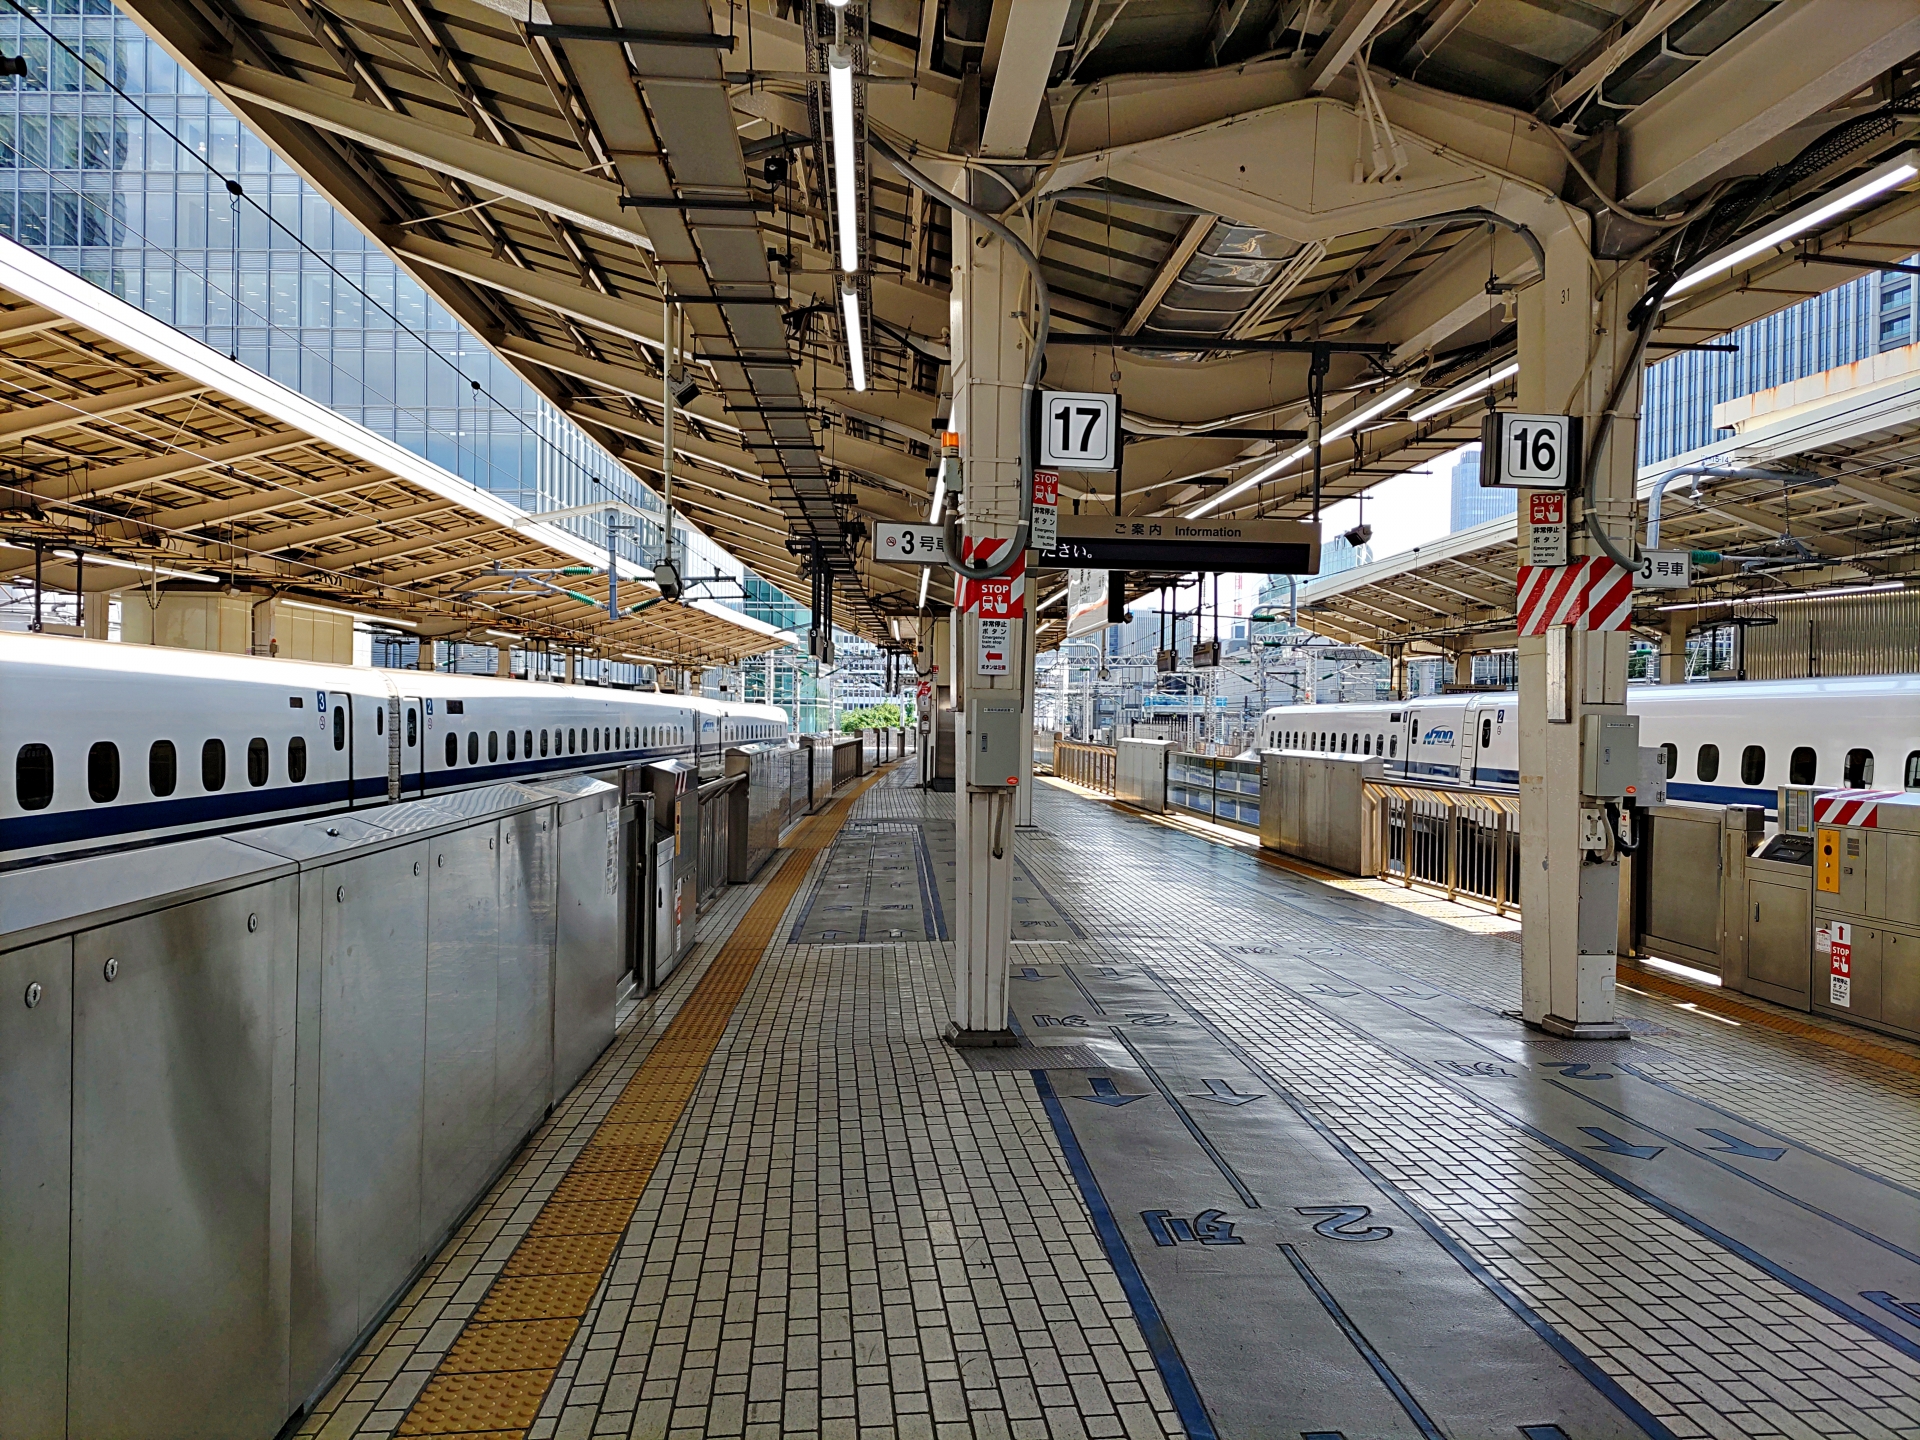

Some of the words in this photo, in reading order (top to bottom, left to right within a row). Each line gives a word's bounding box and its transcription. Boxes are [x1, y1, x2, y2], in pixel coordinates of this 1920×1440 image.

[1561, 287, 1570, 305] 31
[1054, 406, 1102, 453] 17
[1513, 427, 1556, 472] 16
[1034, 473, 1058, 485] STOP
[1532, 495, 1561, 504] STOP
[1033, 517, 1056, 526] ボタン
[1115, 523, 1162, 536] ご案内
[1175, 526, 1242, 537] Information
[1533, 536, 1560, 544] ボタン
[981, 584, 1010, 594] STOP
[1832, 946, 1849, 956] STOP
[1294, 1205, 1394, 1242] 2
